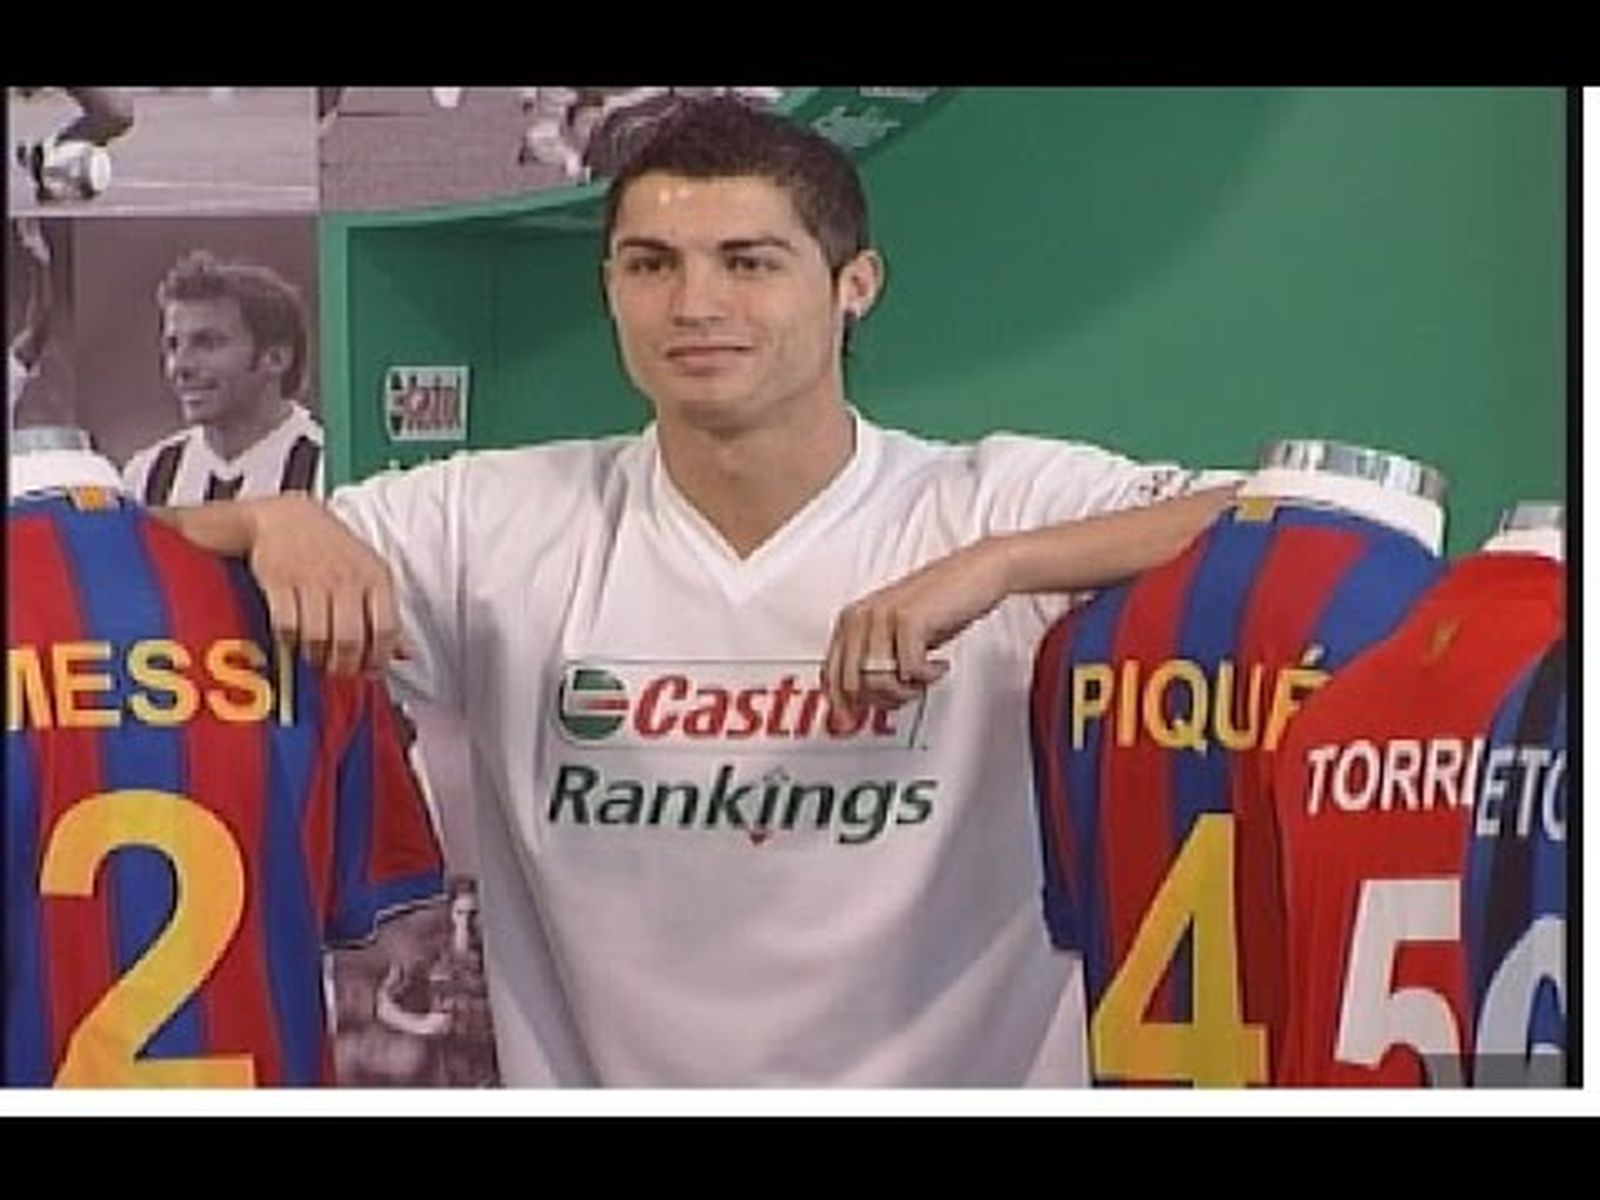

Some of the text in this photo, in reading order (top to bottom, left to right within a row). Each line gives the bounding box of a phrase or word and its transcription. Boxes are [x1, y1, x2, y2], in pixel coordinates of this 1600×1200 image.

[40, 788, 257, 1088] 2
[548, 764, 939, 845] Rankings
[1091, 812, 1270, 1088] 4
